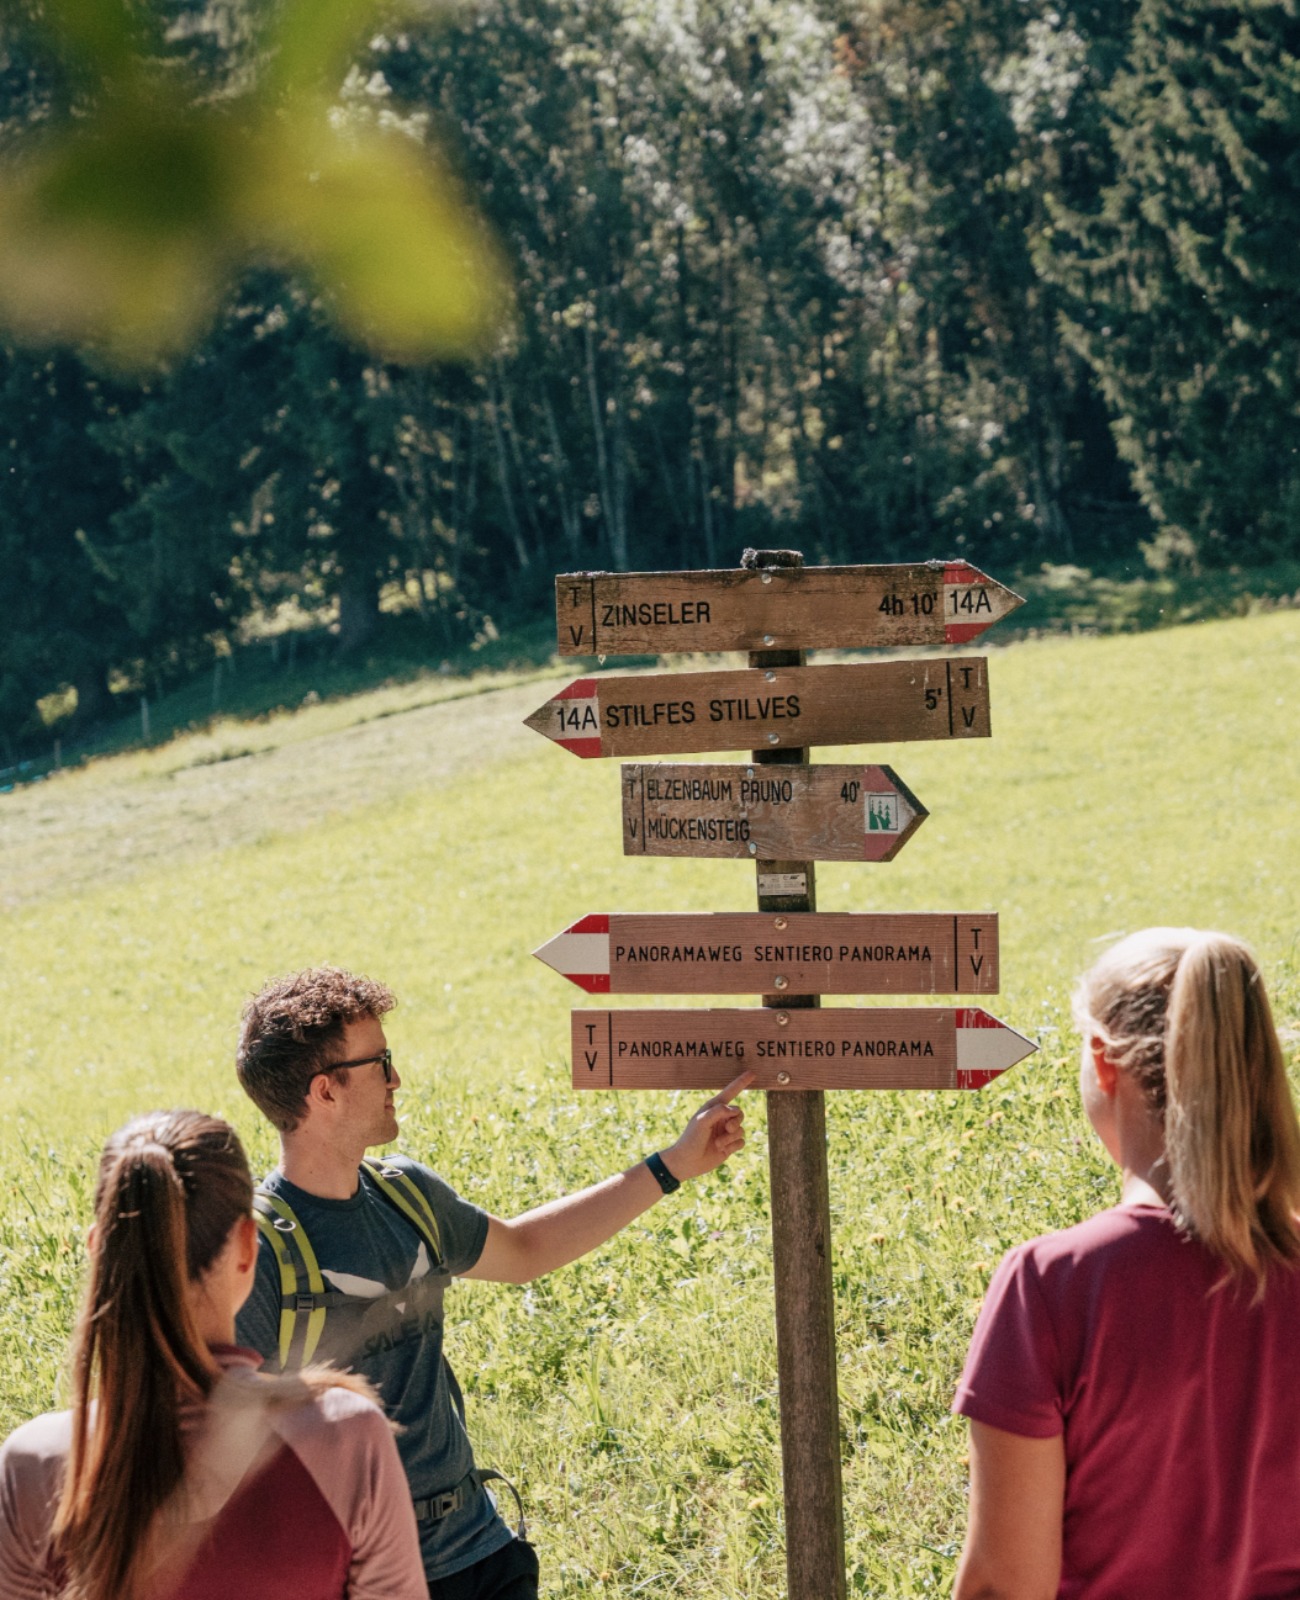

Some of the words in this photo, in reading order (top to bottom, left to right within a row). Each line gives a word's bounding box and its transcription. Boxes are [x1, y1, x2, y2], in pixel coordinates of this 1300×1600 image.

[569, 586, 582, 607] T
[950, 588, 992, 614] 14A
[601, 601, 711, 627] ZINSELER
[878, 595, 904, 616] 4h
[910, 593, 938, 616] 10'
[569, 624, 583, 647] V
[959, 667, 973, 689] T
[557, 705, 598, 732] 14A
[606, 701, 696, 728] STILFES
[709, 694, 801, 722] STILVES
[924, 687, 942, 710] 5'
[961, 706, 975, 728] V
[626, 778, 637, 800] T
[647, 778, 732, 801] ELZENBAUM
[741, 779, 793, 802] PRUNO
[628, 818, 638, 838] V
[647, 813, 751, 842] MÜCKENSTEIG
[970, 928, 983, 950] T
[616, 945, 742, 962] PANORAMAWEG
[754, 945, 833, 962] SENTIERO
[839, 945, 932, 962] PANORAMA
[970, 954, 984, 976] V
[585, 1024, 597, 1046] T
[618, 1040, 745, 1057] PANORAMAWEG
[756, 1040, 836, 1057] SENTIERO
[841, 1040, 934, 1057] PANORAMA
[584, 1051, 598, 1072] V
